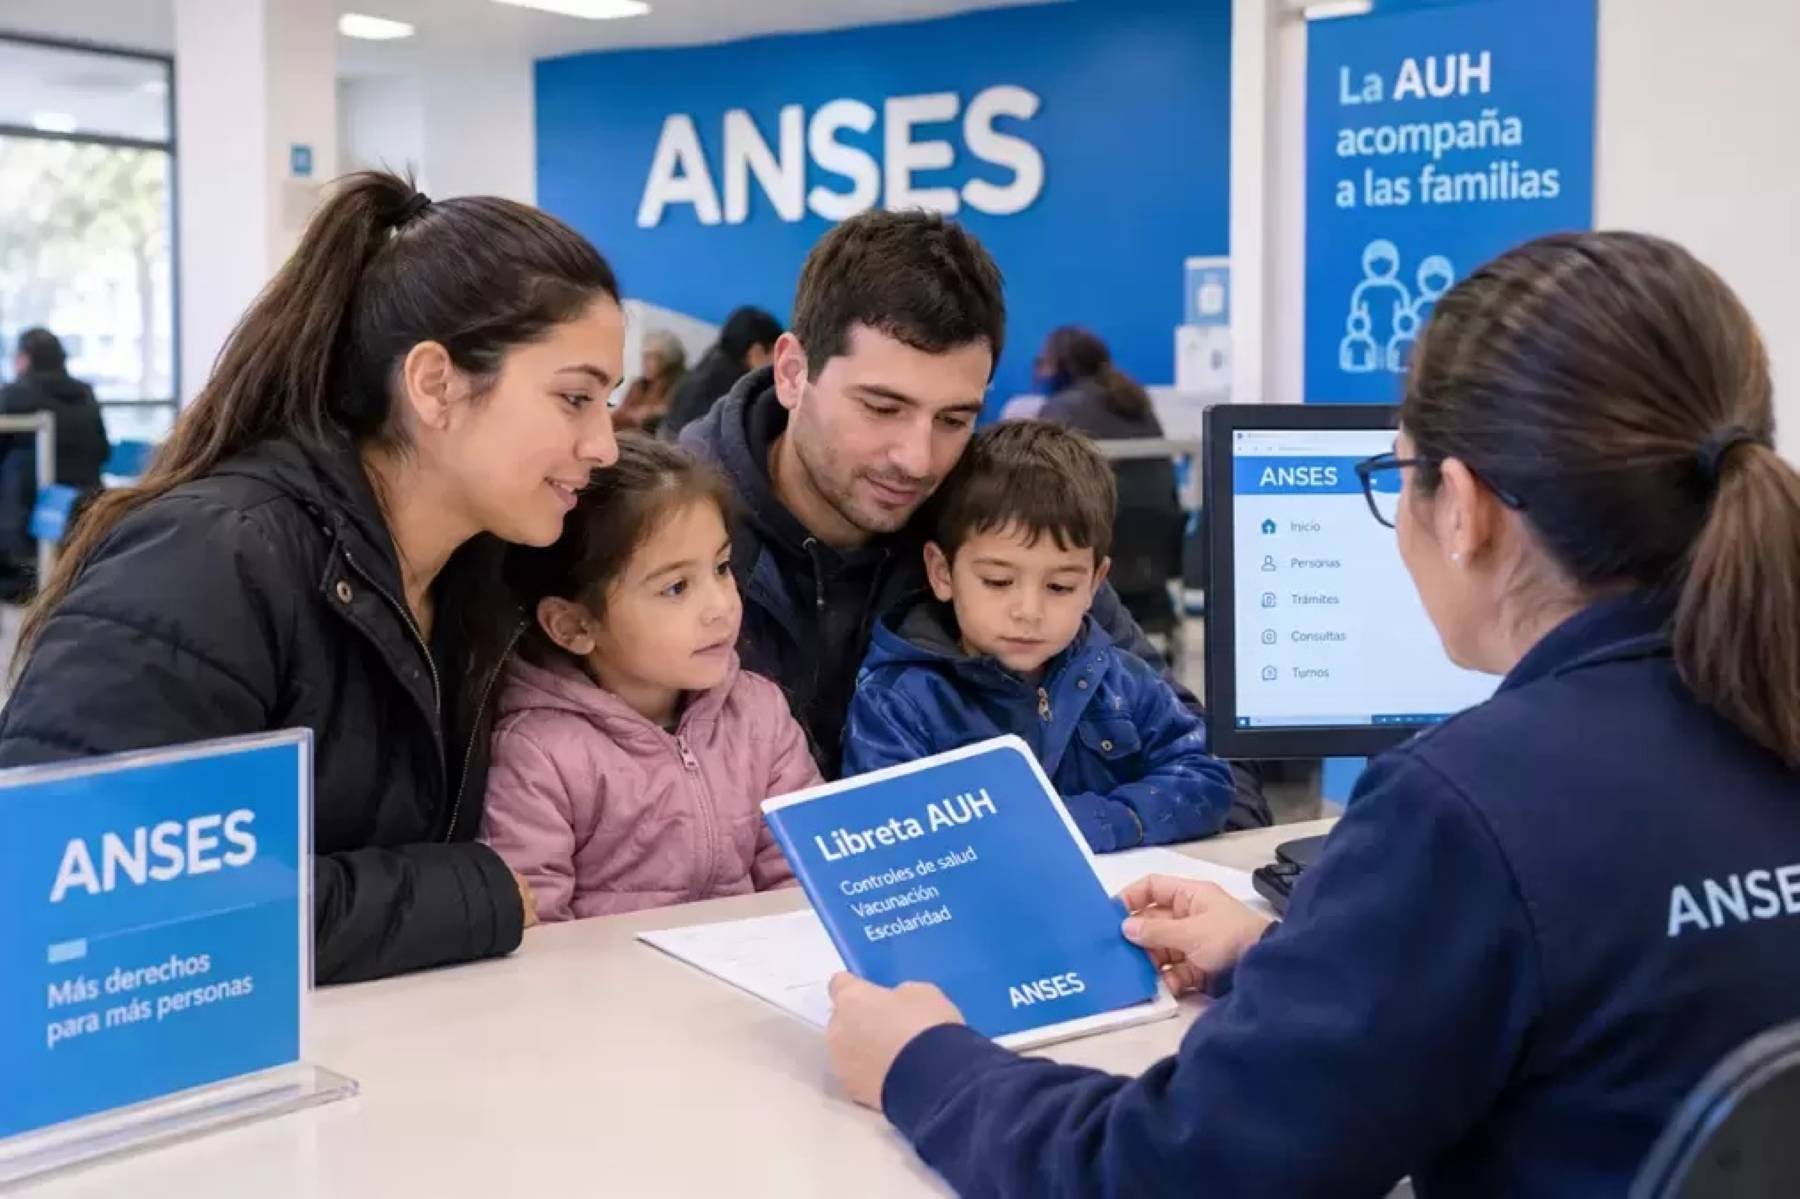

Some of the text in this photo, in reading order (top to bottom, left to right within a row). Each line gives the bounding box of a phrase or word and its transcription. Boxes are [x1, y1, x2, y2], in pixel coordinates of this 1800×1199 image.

[1339, 50, 1492, 104] La AUH
[636, 84, 1046, 227] ANSES
[1336, 109, 1522, 159] acompaña
[1336, 160, 1560, 208] a las familias
[1259, 466, 1338, 487] ANSES
[1290, 520, 1321, 532] Inicio
[1290, 557, 1341, 569] Personas
[1291, 592, 1340, 605] Trámites
[1291, 629, 1347, 642] Consultas
[815, 788, 997, 862] Libreta AUH
[49, 808, 257, 904] ANSES
[840, 845, 979, 898] Controles de salud
[851, 883, 940, 919] Vacunación
[865, 903, 953, 943] Escolaridad
[48, 952, 211, 1010] Más derechos
[1008, 971, 1086, 1008] ANSES
[47, 974, 254, 1050] para más personas
